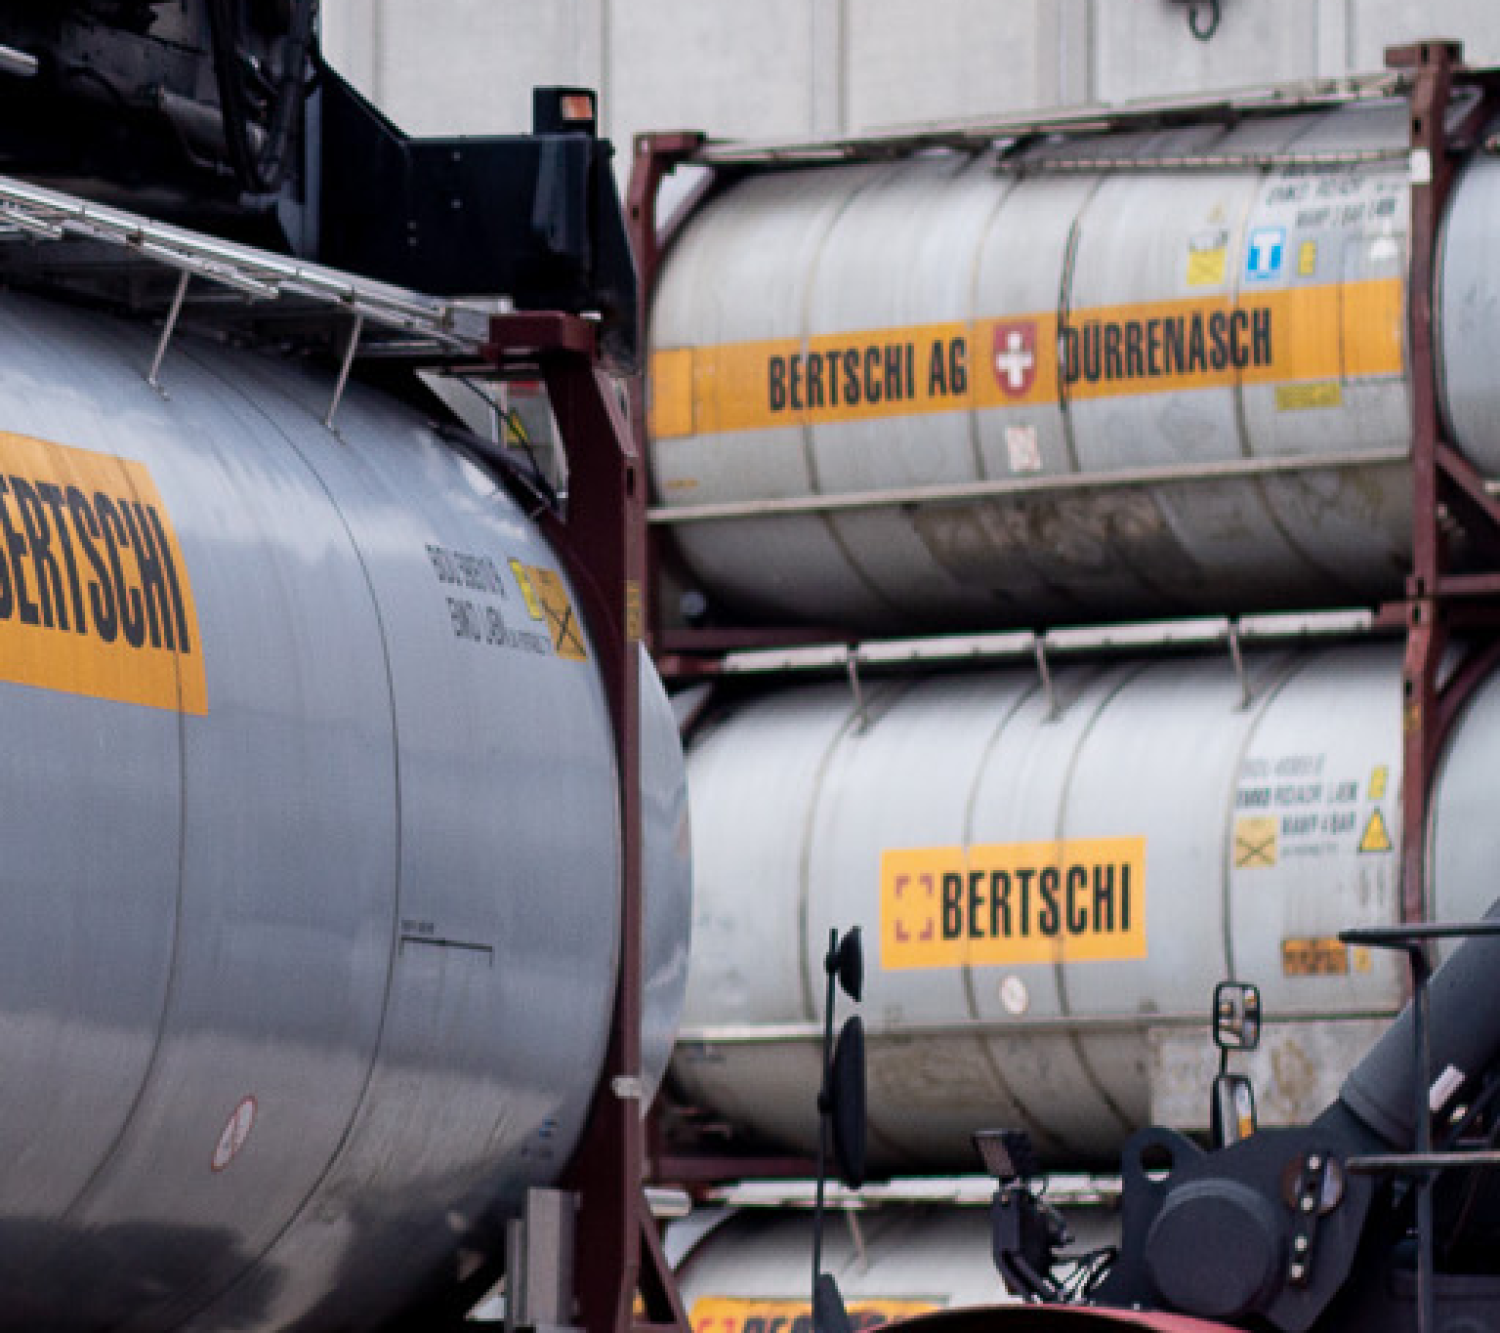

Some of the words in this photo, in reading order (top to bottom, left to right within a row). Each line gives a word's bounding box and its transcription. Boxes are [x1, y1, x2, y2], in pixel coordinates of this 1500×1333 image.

[769, 345, 914, 411] BERTSCHI
[928, 336, 968, 394] AG
[942, 863, 1131, 940] BERTSCHI
